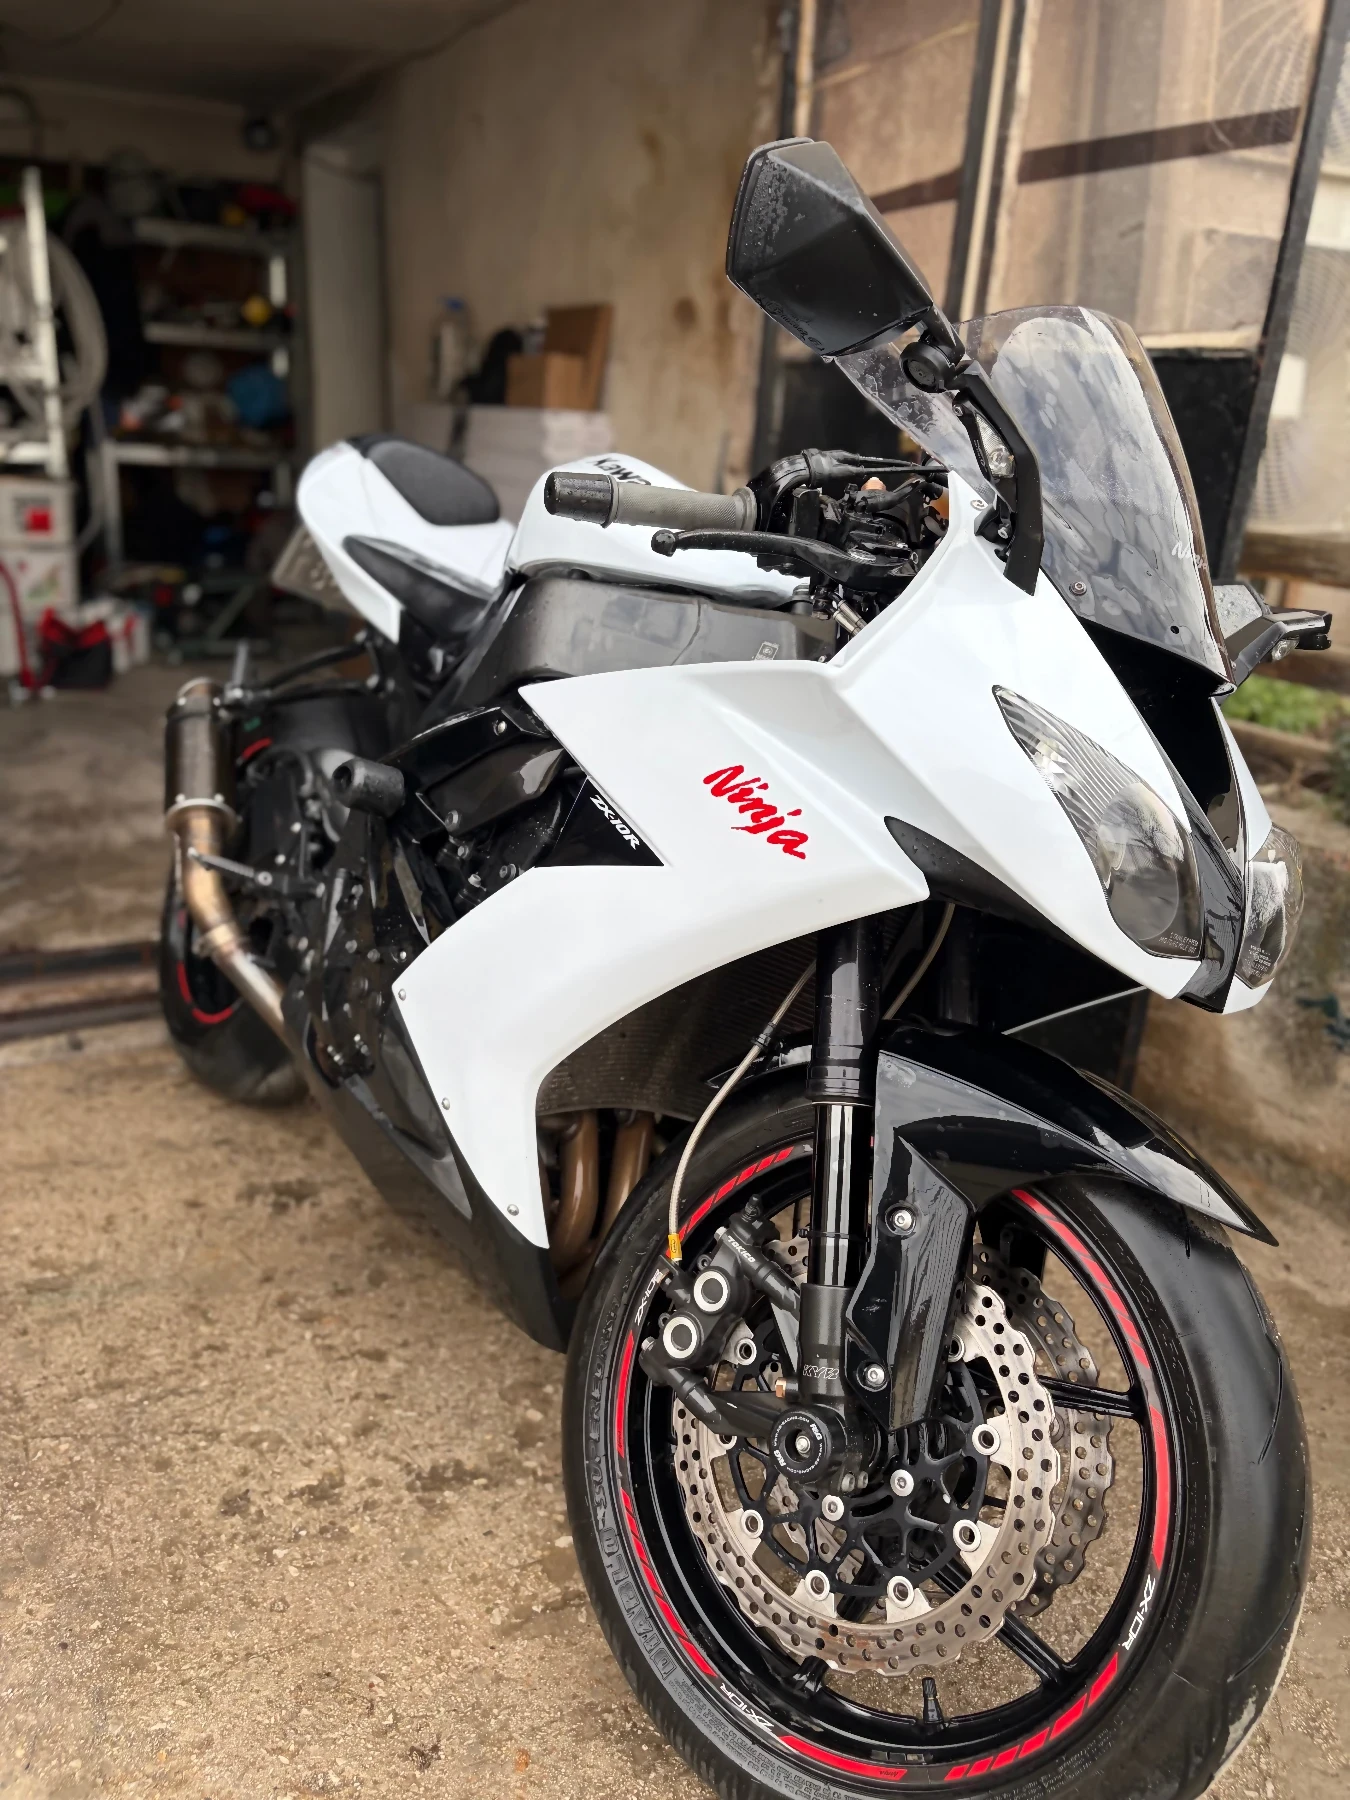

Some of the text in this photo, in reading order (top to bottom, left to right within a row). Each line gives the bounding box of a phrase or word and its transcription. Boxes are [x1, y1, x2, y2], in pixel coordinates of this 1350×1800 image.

[589, 794, 640, 850] ZX-10R
[703, 765, 808, 860] Ninja
[727, 1235, 756, 1263] TOKICO
[1121, 1573, 1156, 1651] ZX-10R
[719, 1682, 775, 1733] ZX-10R
